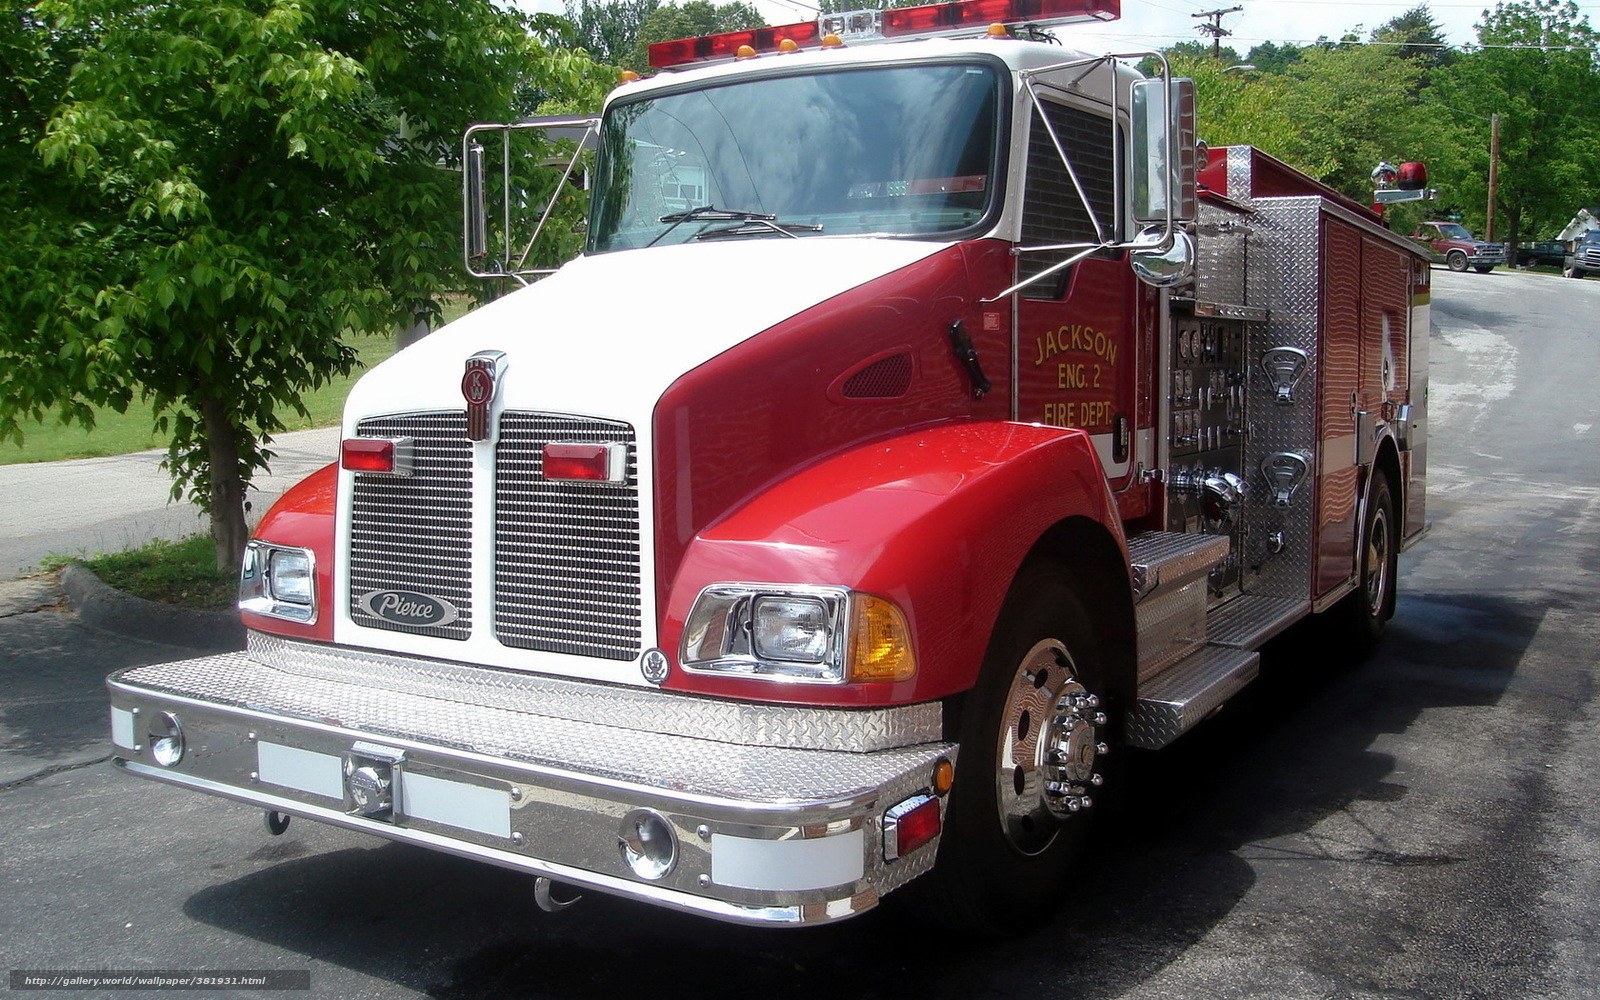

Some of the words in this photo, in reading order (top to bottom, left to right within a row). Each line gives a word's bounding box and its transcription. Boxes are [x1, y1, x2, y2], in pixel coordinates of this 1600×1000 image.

[1035, 324, 1117, 366] JACKSON
[1058, 363, 1088, 389] ENG.
[1093, 364, 1101, 388] 2
[1044, 402, 1075, 427] FIRE
[1080, 401, 1112, 427] DEPT.
[379, 593, 434, 619] Pierce
